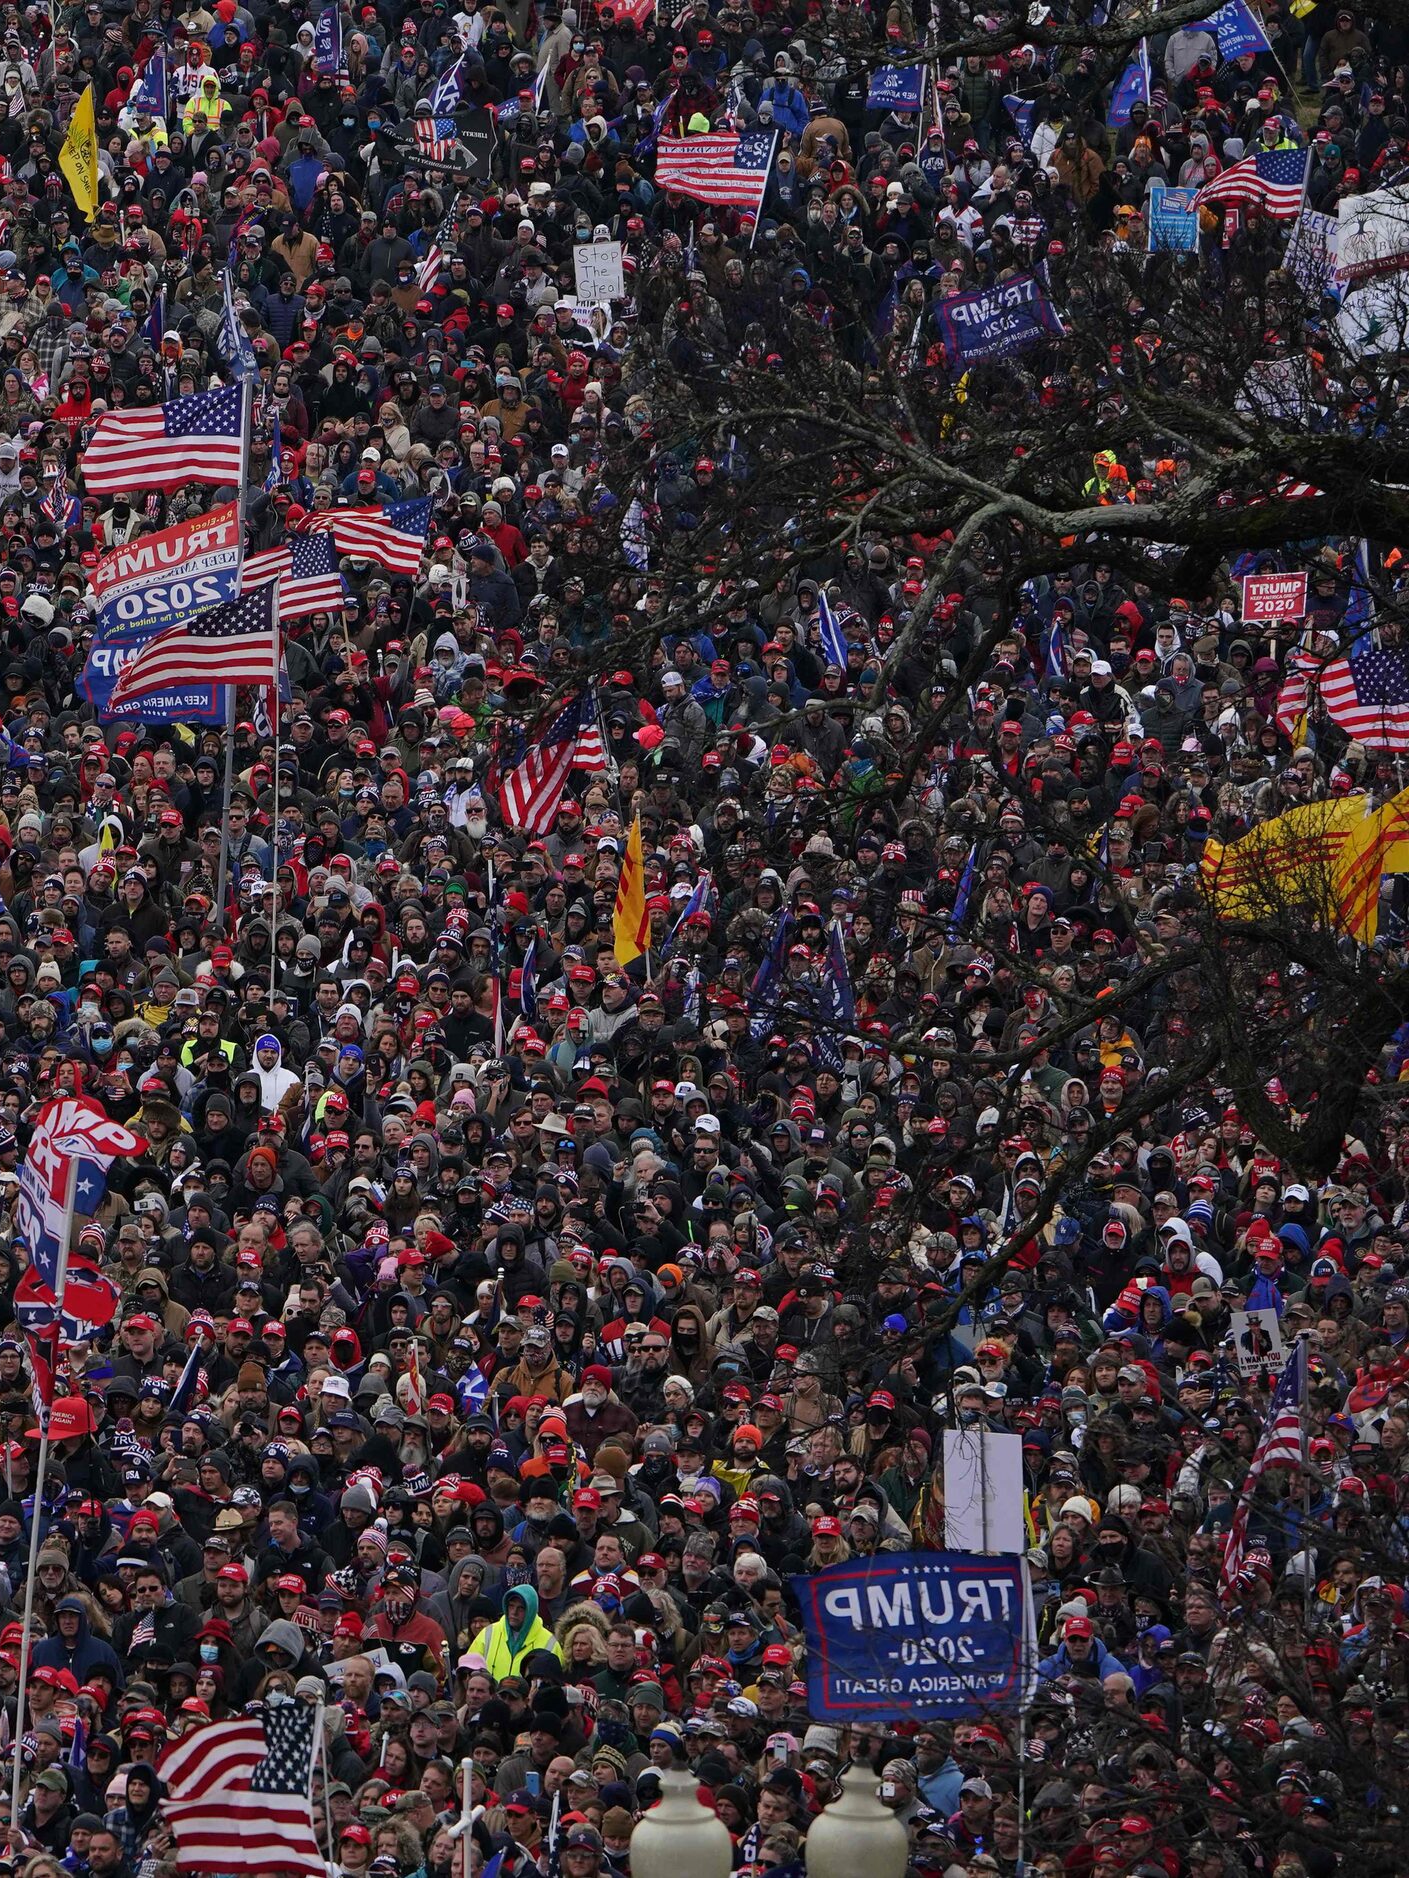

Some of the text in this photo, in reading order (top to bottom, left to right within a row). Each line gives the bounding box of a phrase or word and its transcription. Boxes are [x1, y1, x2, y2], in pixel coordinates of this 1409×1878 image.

[578, 246, 619, 269] Stop
[581, 264, 611, 281] The
[1250, 580, 1301, 595] TRUMP
[1254, 599, 1294, 613] 2020
[1245, 1355, 1265, 1364] WANT
[1266, 1353, 1281, 1362] YOU
[50, 1411, 76, 1421] AMERICA
[126, 1470, 140, 1480] USA
